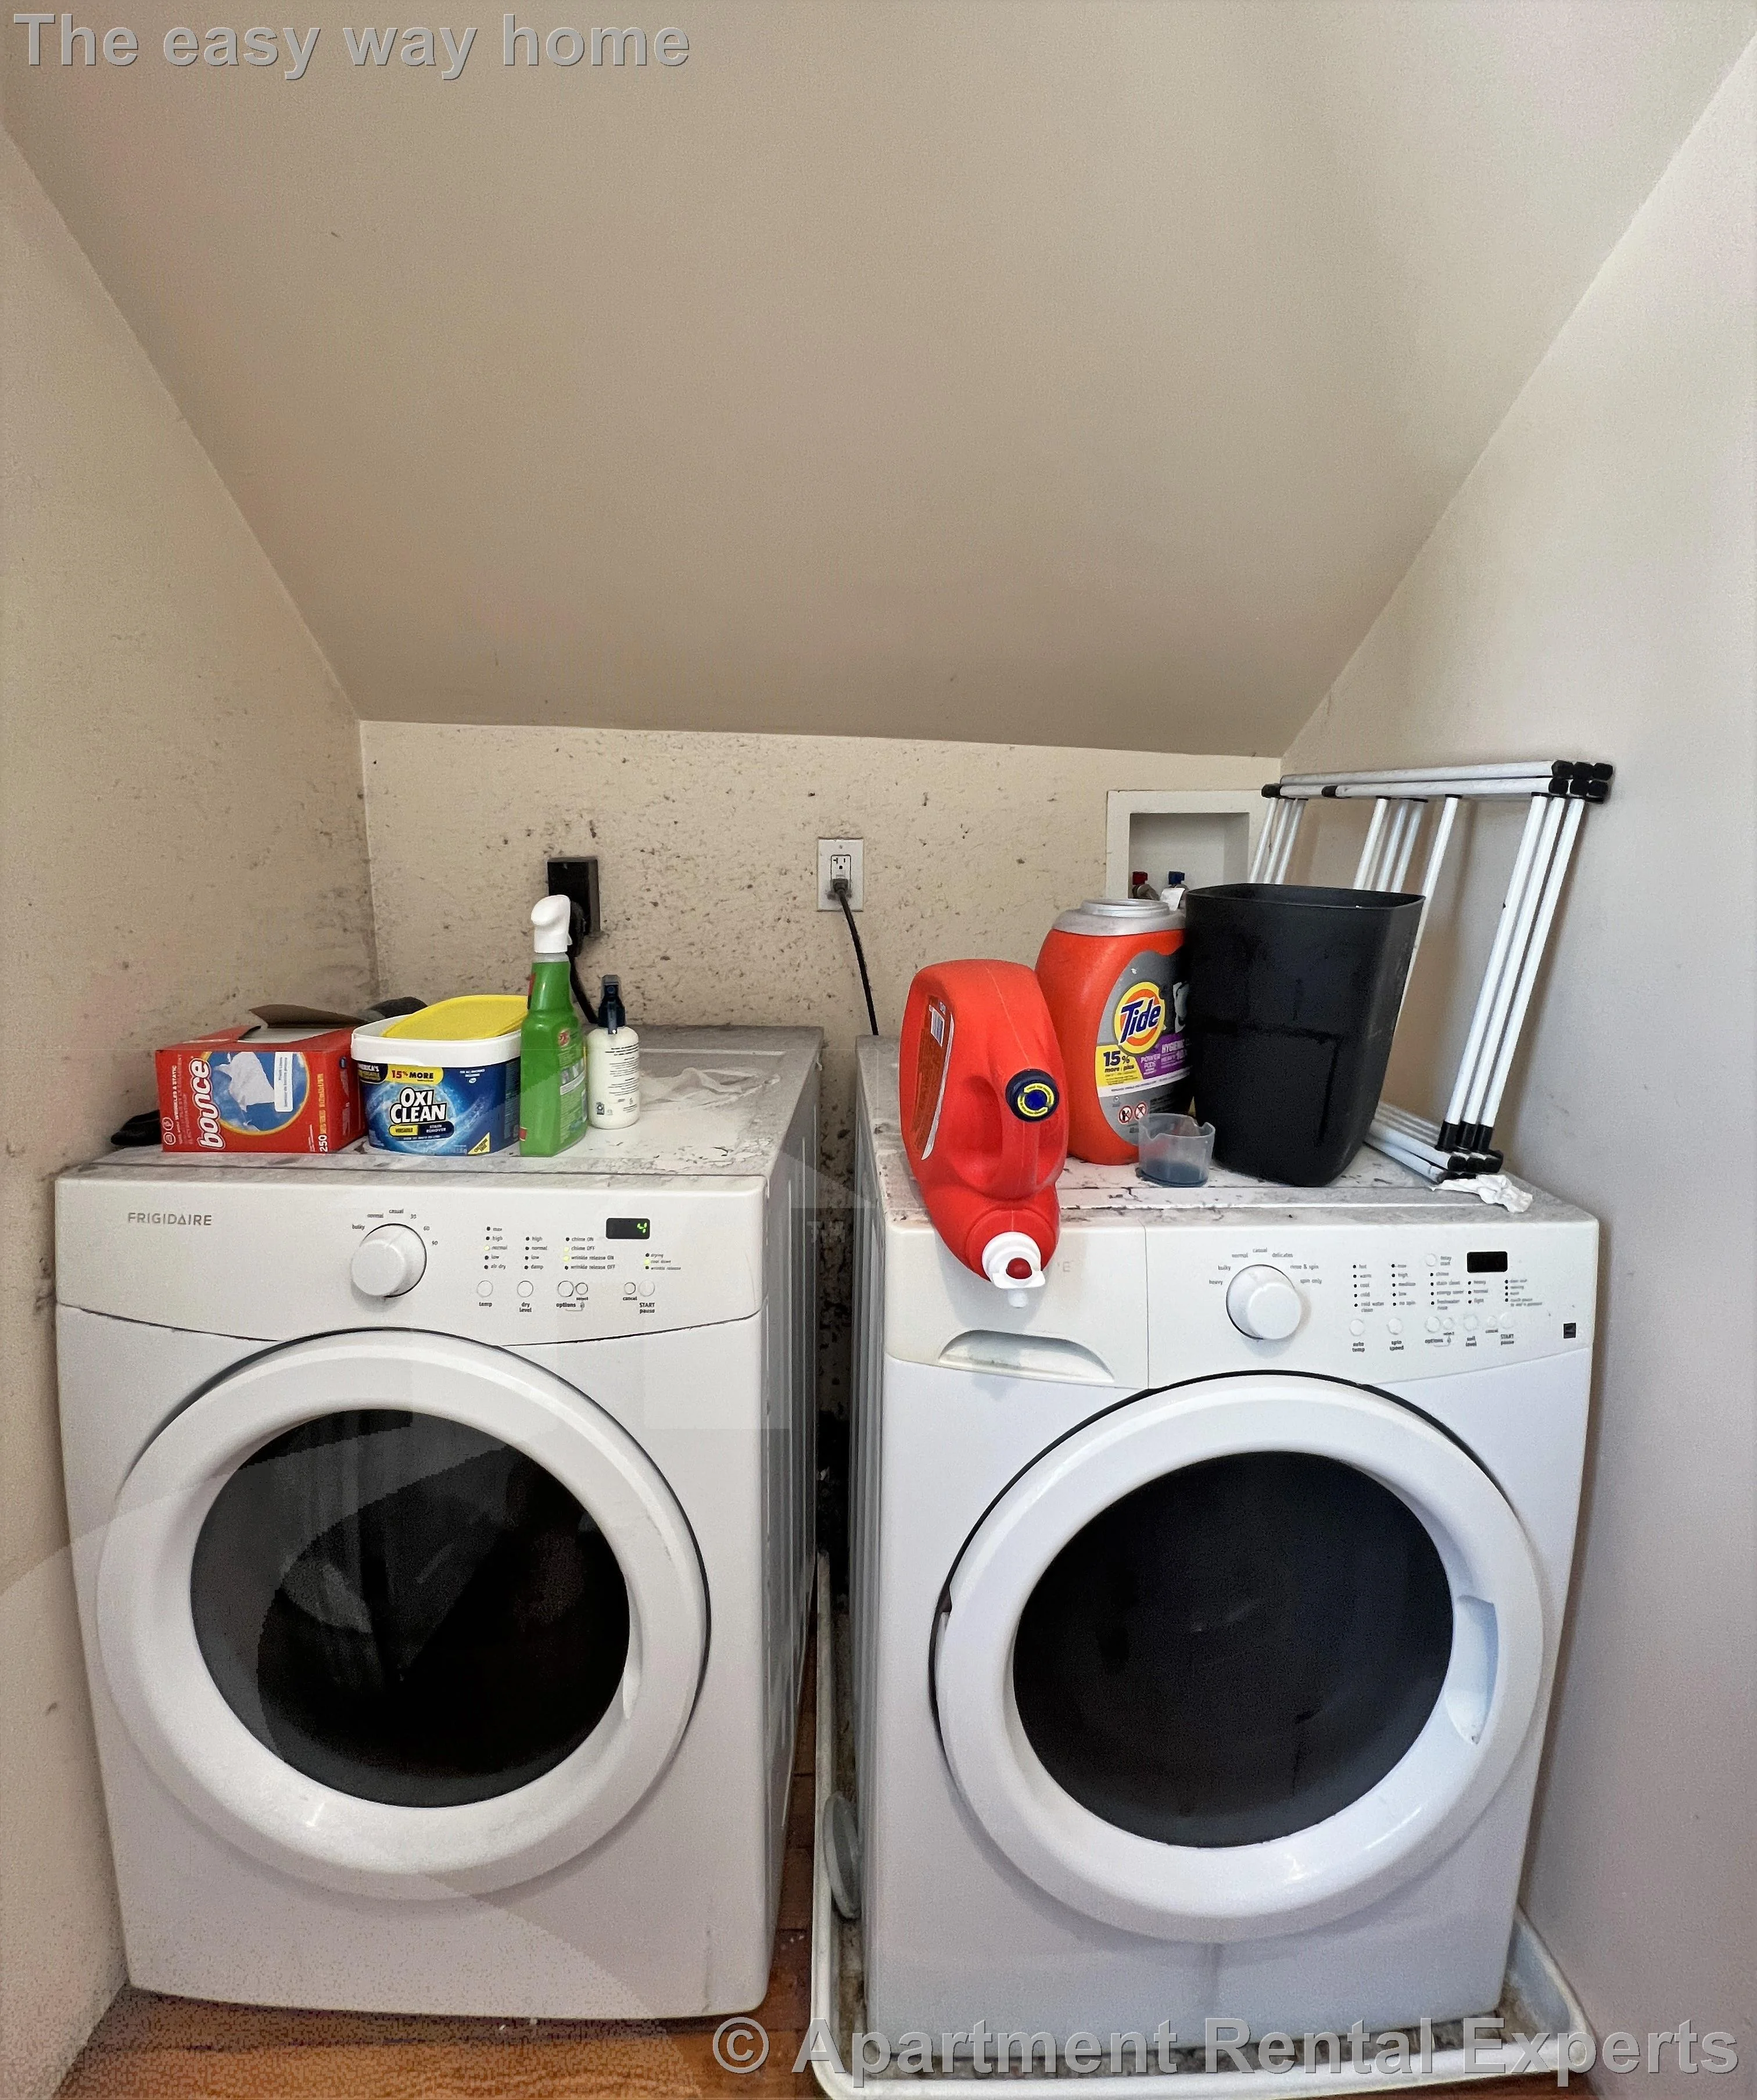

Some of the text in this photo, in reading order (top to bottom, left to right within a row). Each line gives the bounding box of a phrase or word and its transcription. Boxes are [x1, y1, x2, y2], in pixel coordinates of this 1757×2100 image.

[1120, 998, 1161, 1044] Tide
[189, 1058, 225, 1150] bounce
[400, 1088, 433, 1107] OXI
[390, 1103, 446, 1124] CLEAN
[318, 1134, 328, 1153] 250
[127, 1212, 212, 1226] FRIGIDAIRE
